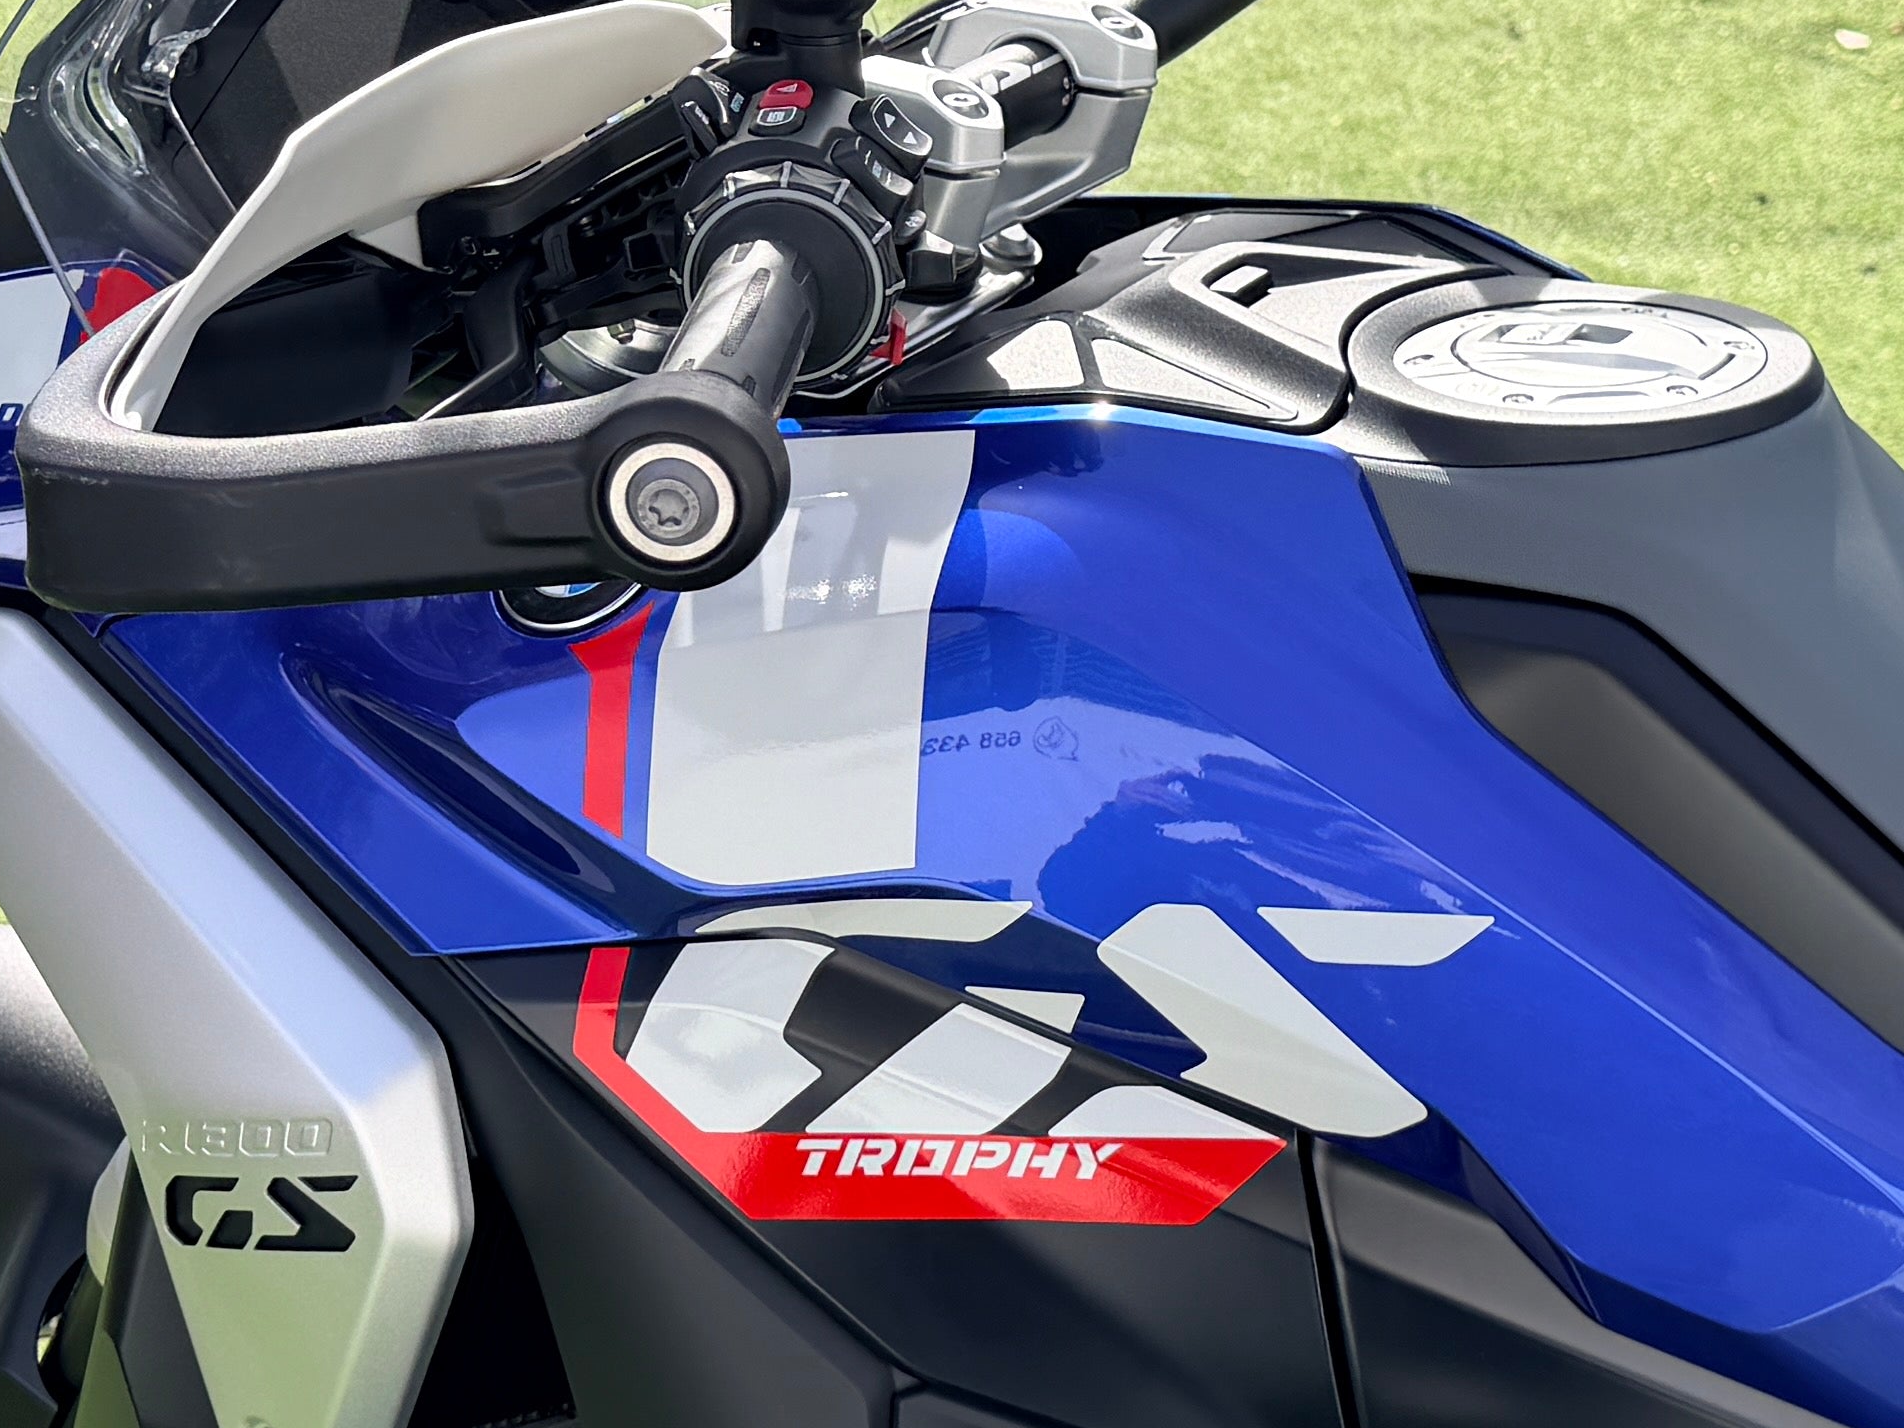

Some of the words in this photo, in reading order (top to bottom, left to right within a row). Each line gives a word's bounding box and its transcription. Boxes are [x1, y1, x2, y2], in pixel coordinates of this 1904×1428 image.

[141, 1118, 333, 1157] R1300
[796, 1138, 1124, 1180] TROPHY
[164, 1175, 359, 1253] GS
